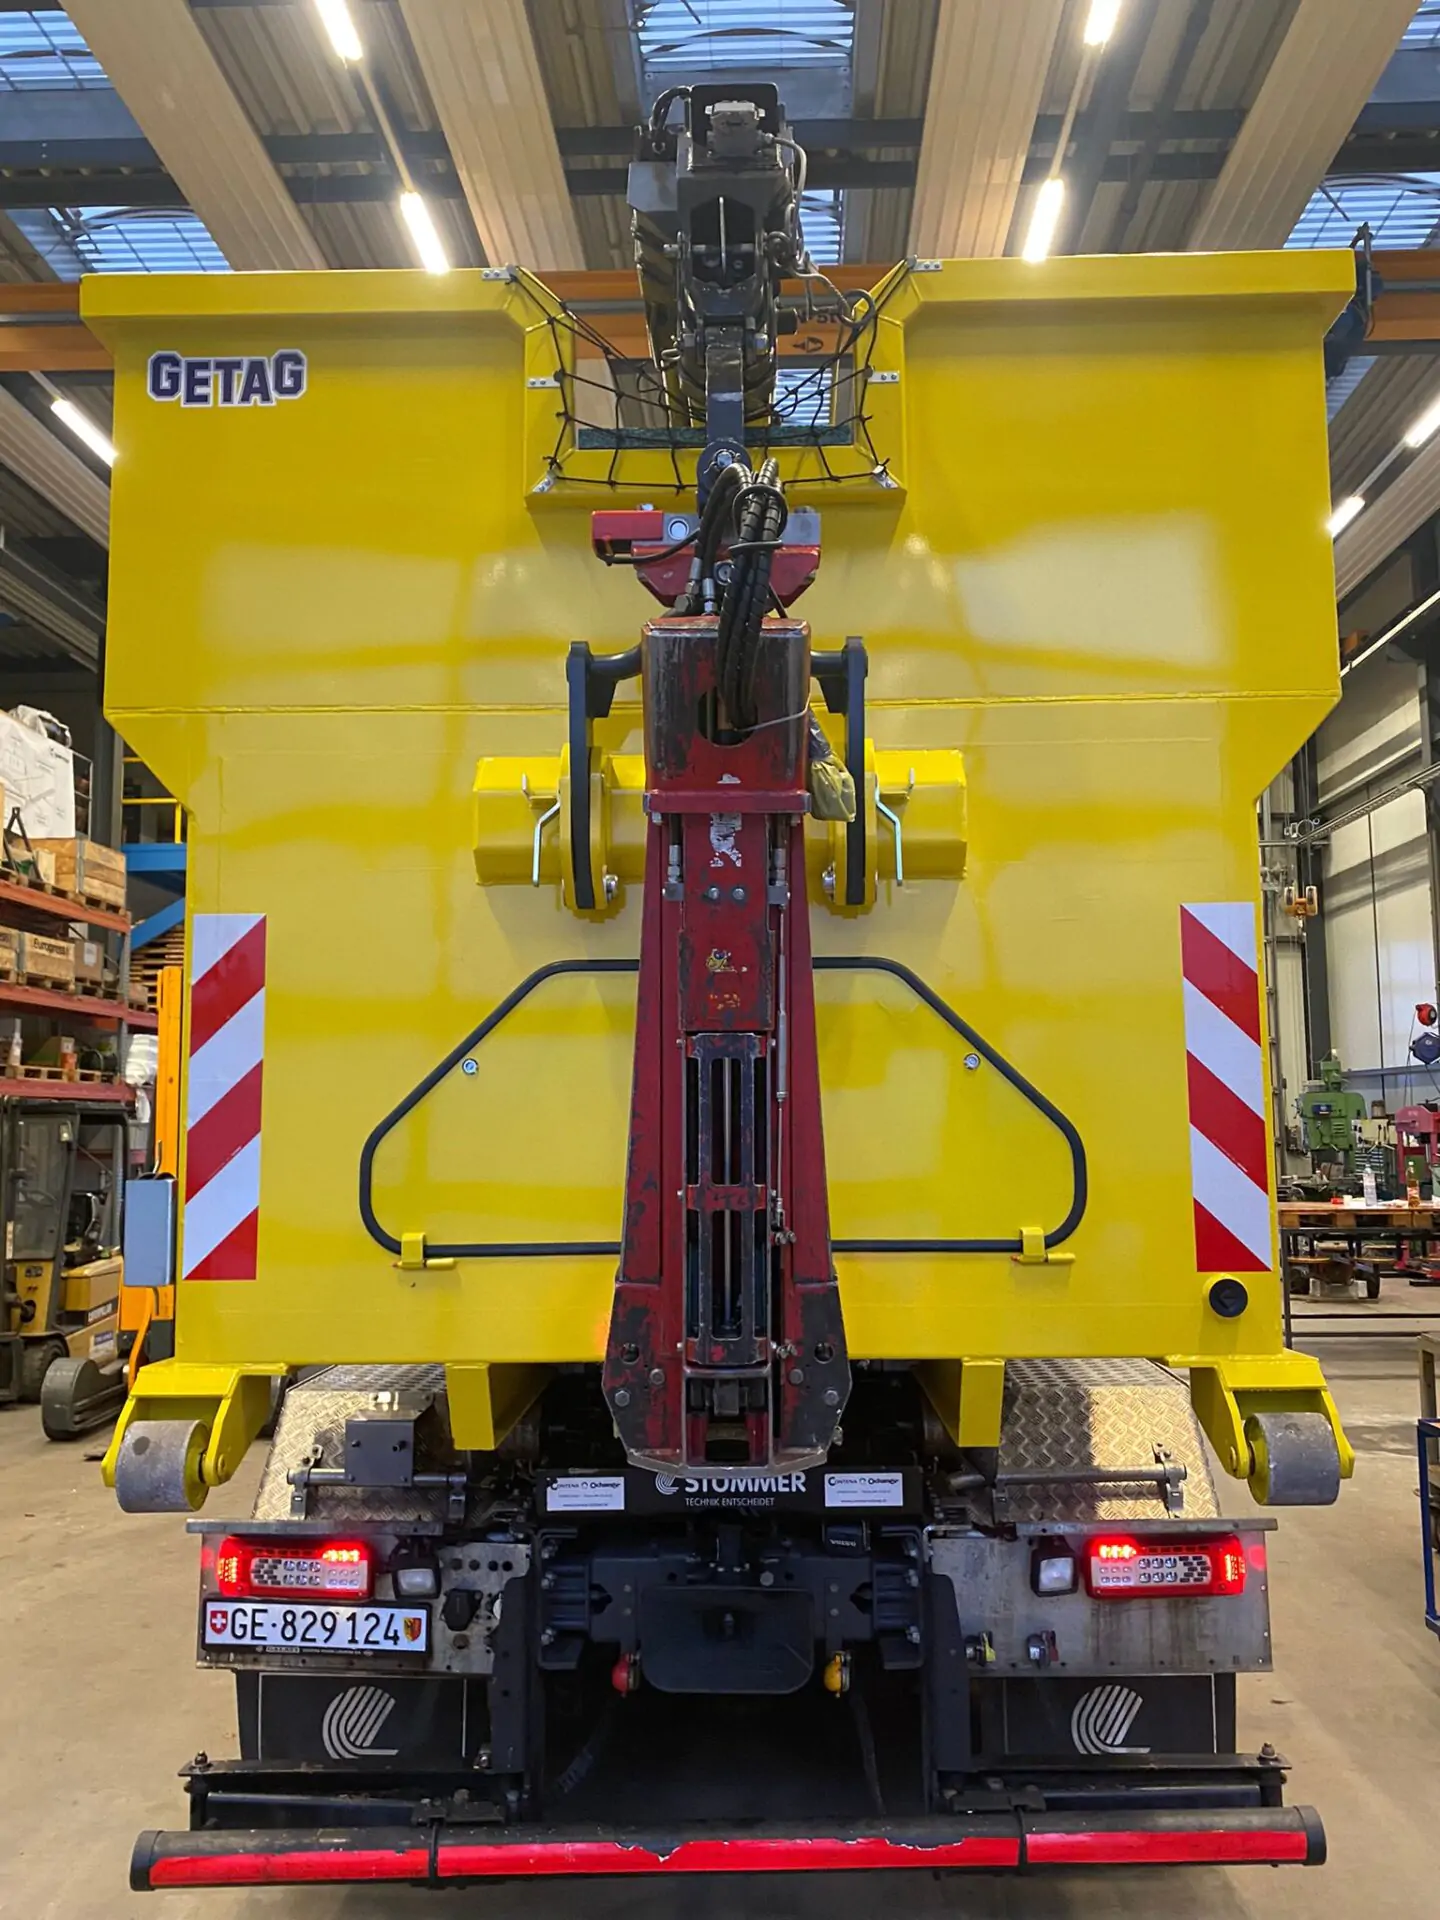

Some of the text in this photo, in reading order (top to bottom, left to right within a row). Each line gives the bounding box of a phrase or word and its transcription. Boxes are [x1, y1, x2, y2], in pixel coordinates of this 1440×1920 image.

[147, 349, 307, 407] GETAG
[685, 1497, 775, 1506] TECHNIK ENTSCHEIDET
